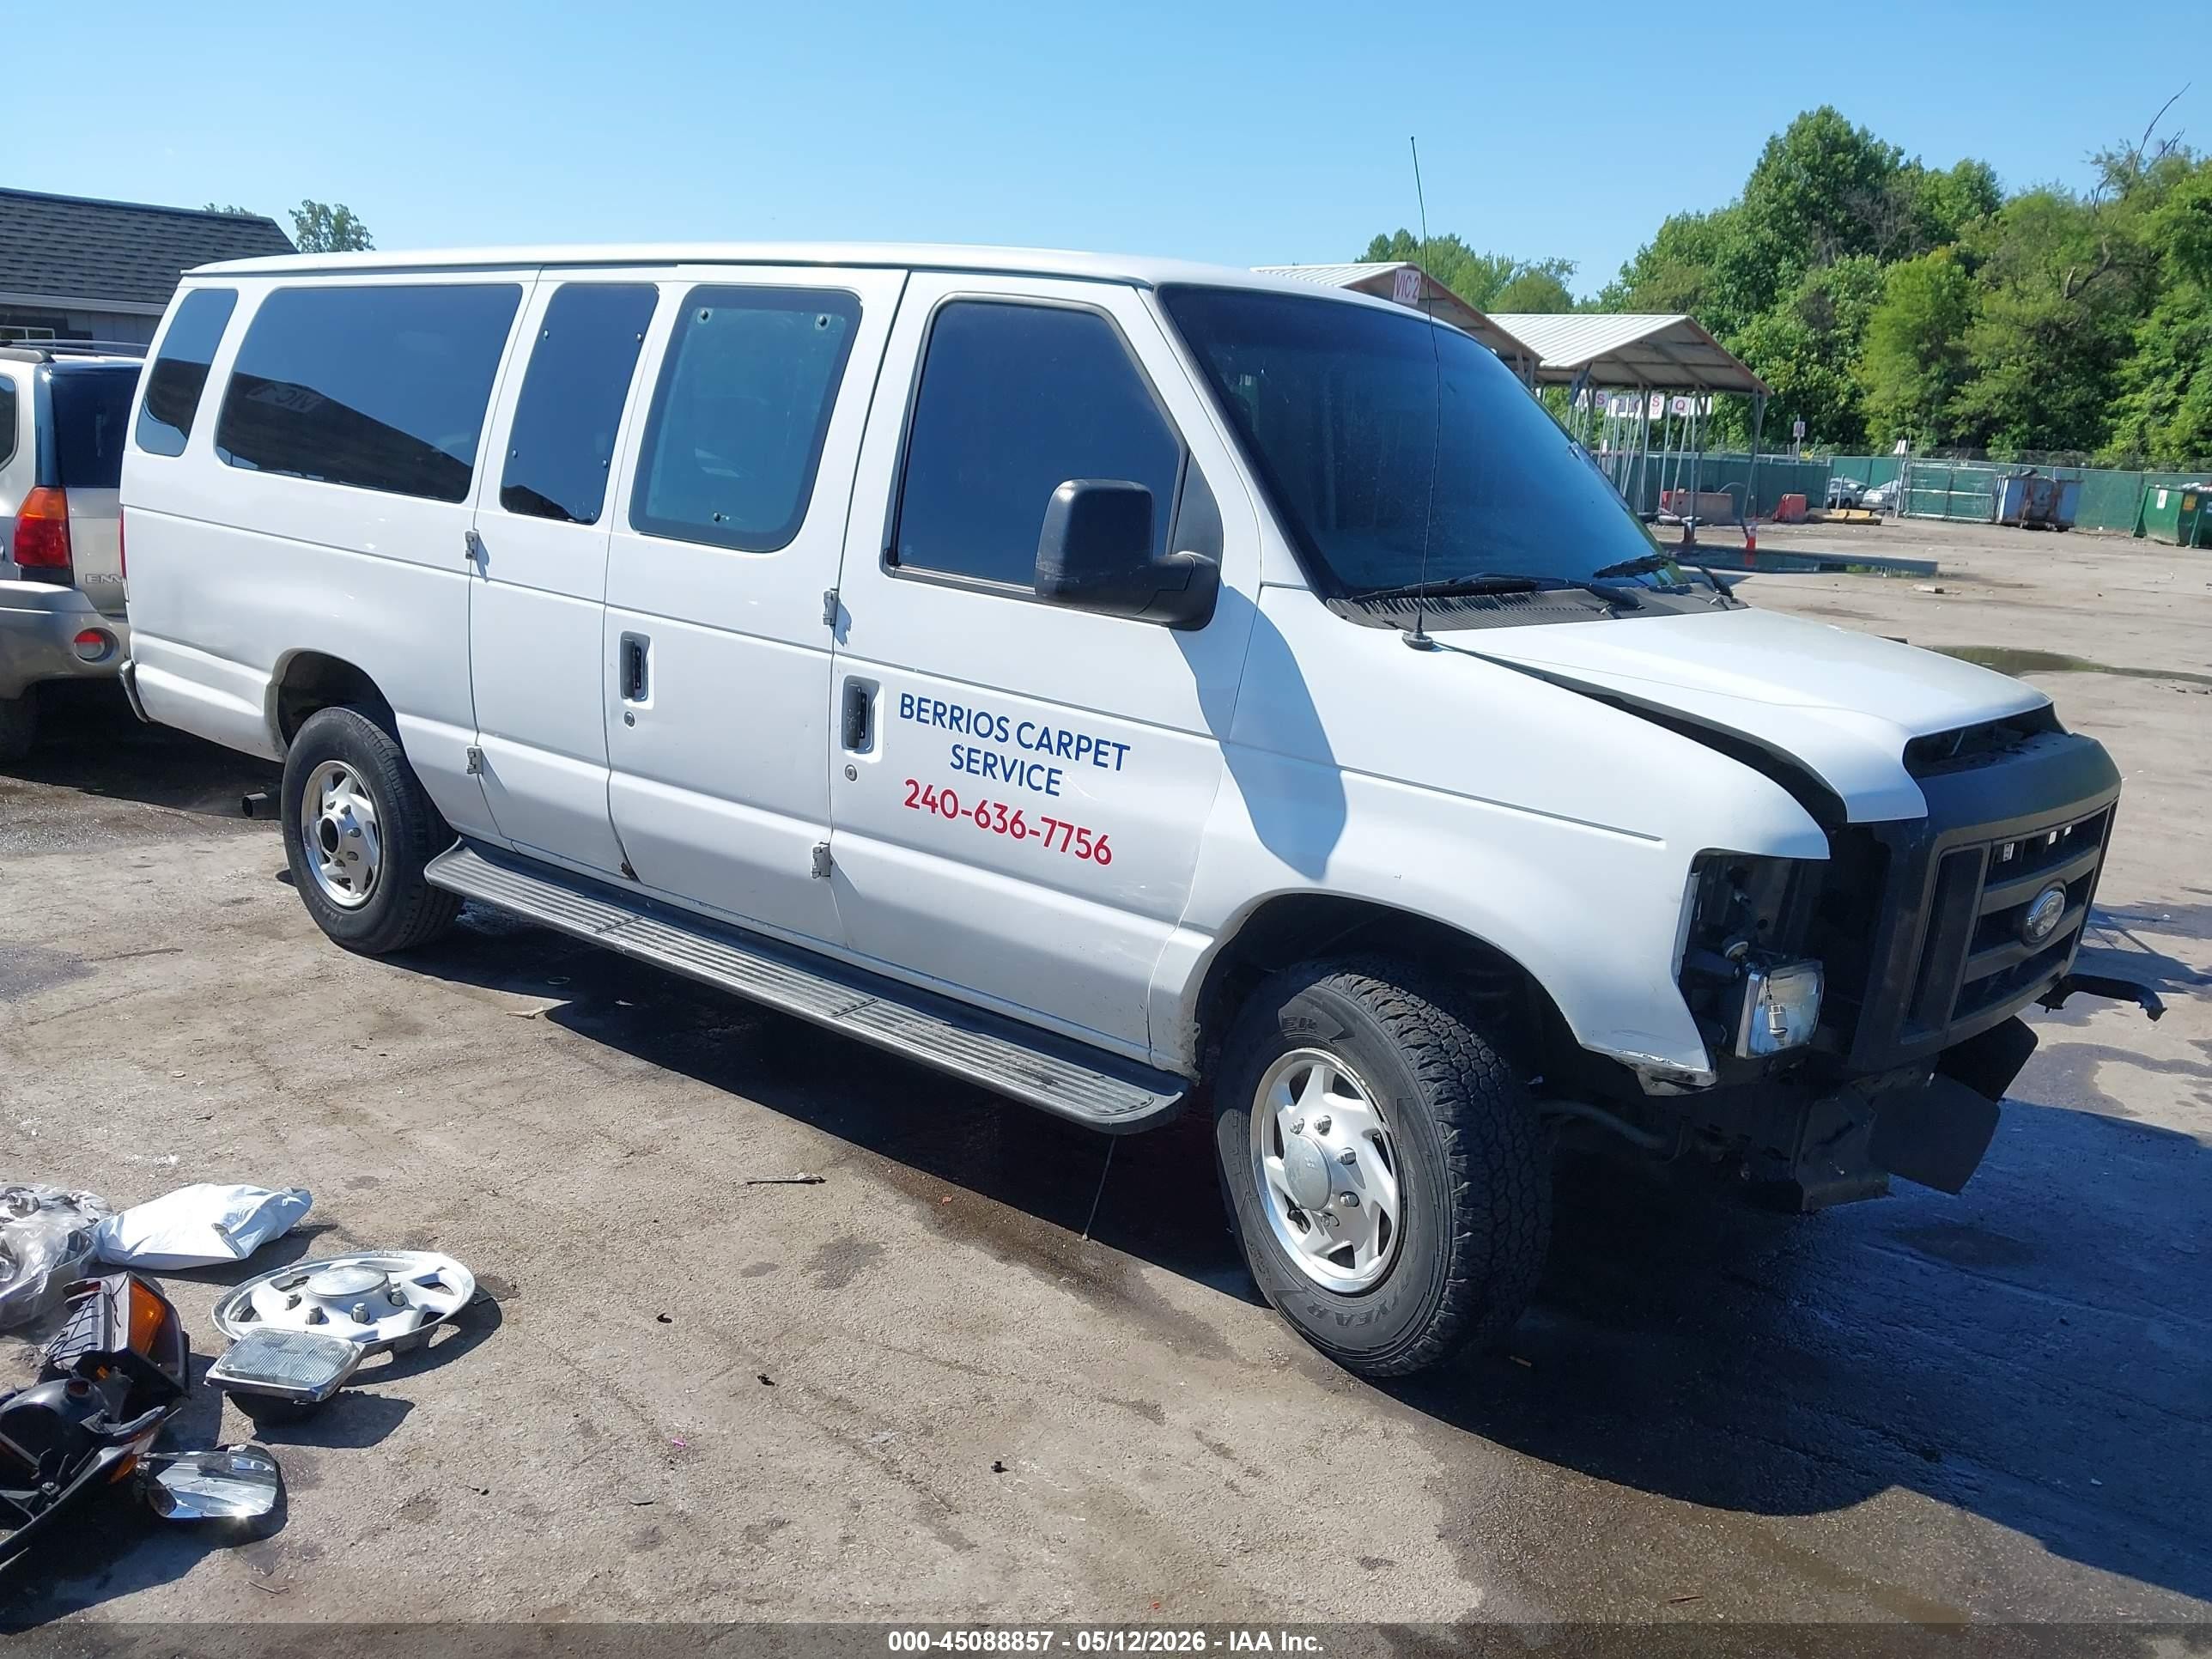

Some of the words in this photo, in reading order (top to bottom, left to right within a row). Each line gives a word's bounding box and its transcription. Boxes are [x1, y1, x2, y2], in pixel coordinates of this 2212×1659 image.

[1396, 272, 1412, 298] VIC
[1413, 276, 1419, 299] 2
[1597, 394, 1605, 404] S
[1652, 396, 1660, 407] S
[1676, 399, 1686, 412] Q
[900, 692, 1011, 743] BERRIOS
[1017, 721, 1131, 771] CARPET
[950, 744, 1063, 797] SERVICE
[904, 778, 1113, 866] 240-636-7756
